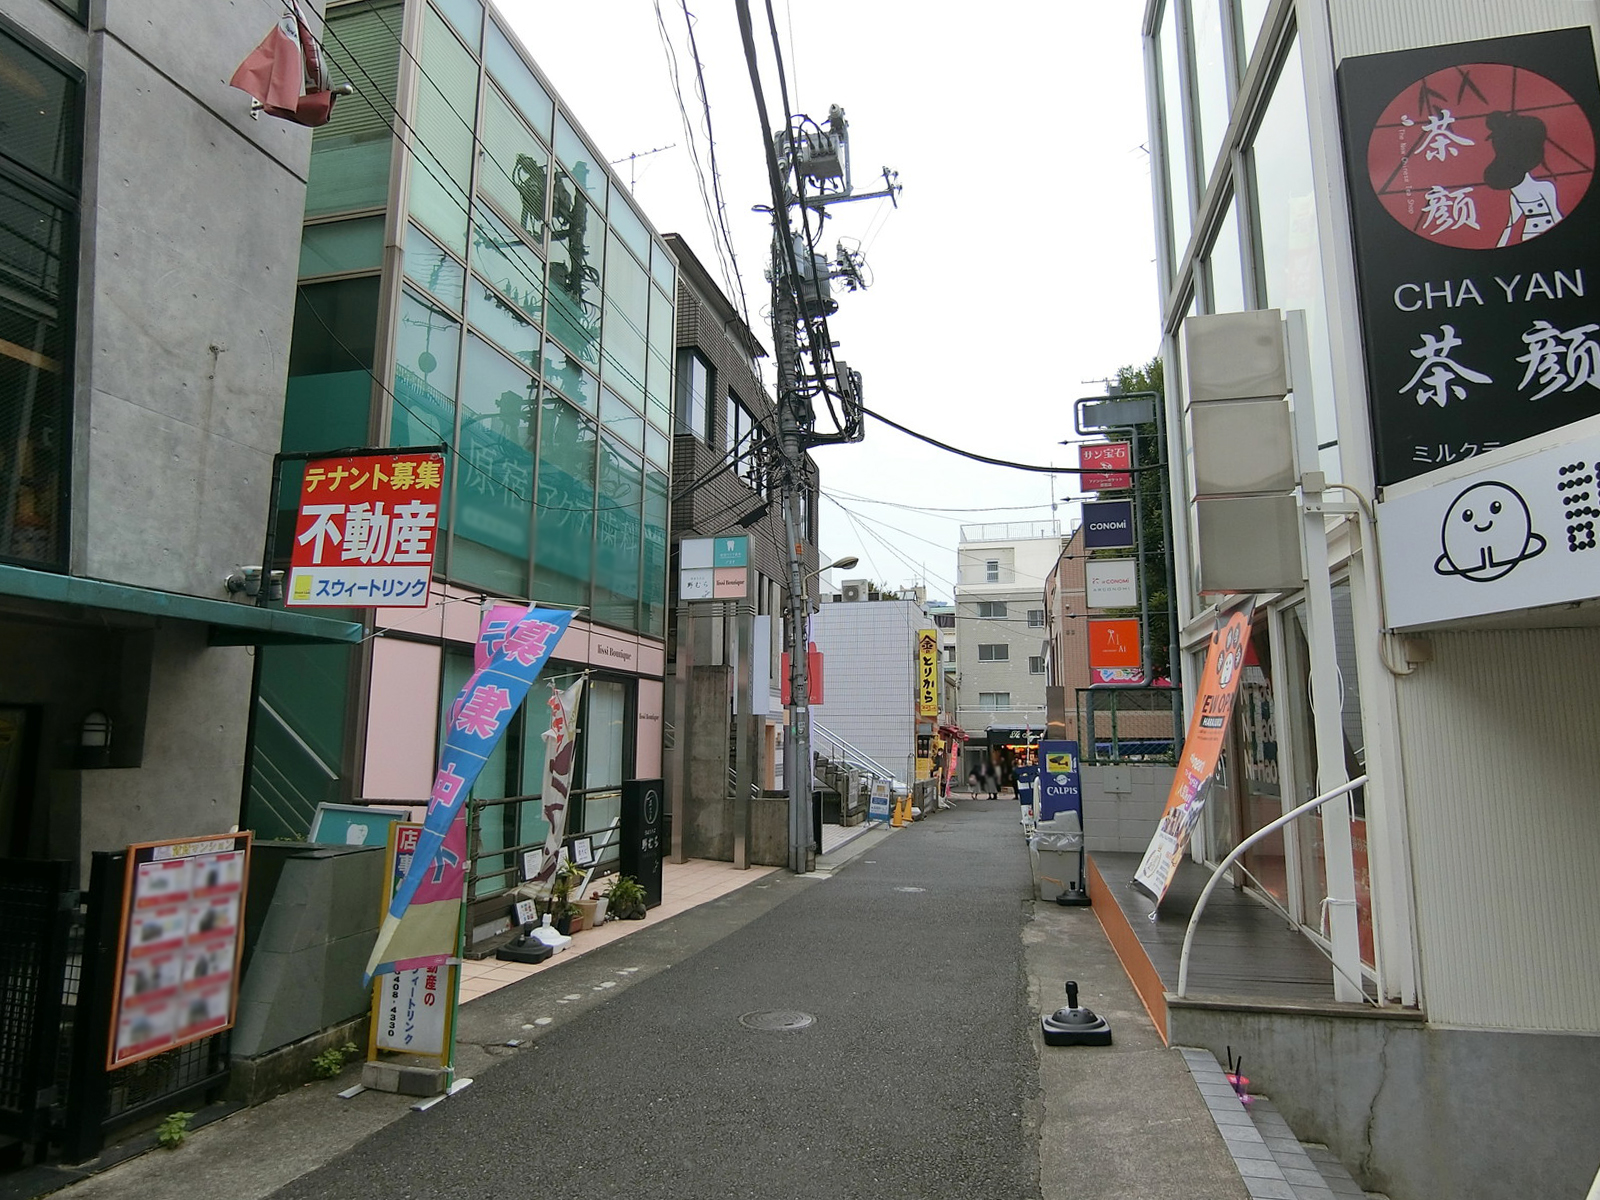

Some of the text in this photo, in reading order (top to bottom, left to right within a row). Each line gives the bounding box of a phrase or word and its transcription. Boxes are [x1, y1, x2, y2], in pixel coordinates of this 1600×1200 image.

[1394, 269, 1586, 312] CHA YAN
[1083, 447, 1125, 460] サン宝石
[305, 461, 441, 493] テナント募集
[298, 500, 437, 564] 不動産
[316, 579, 427, 598] スウィートリンク
[1047, 786, 1078, 796] CALPIS
